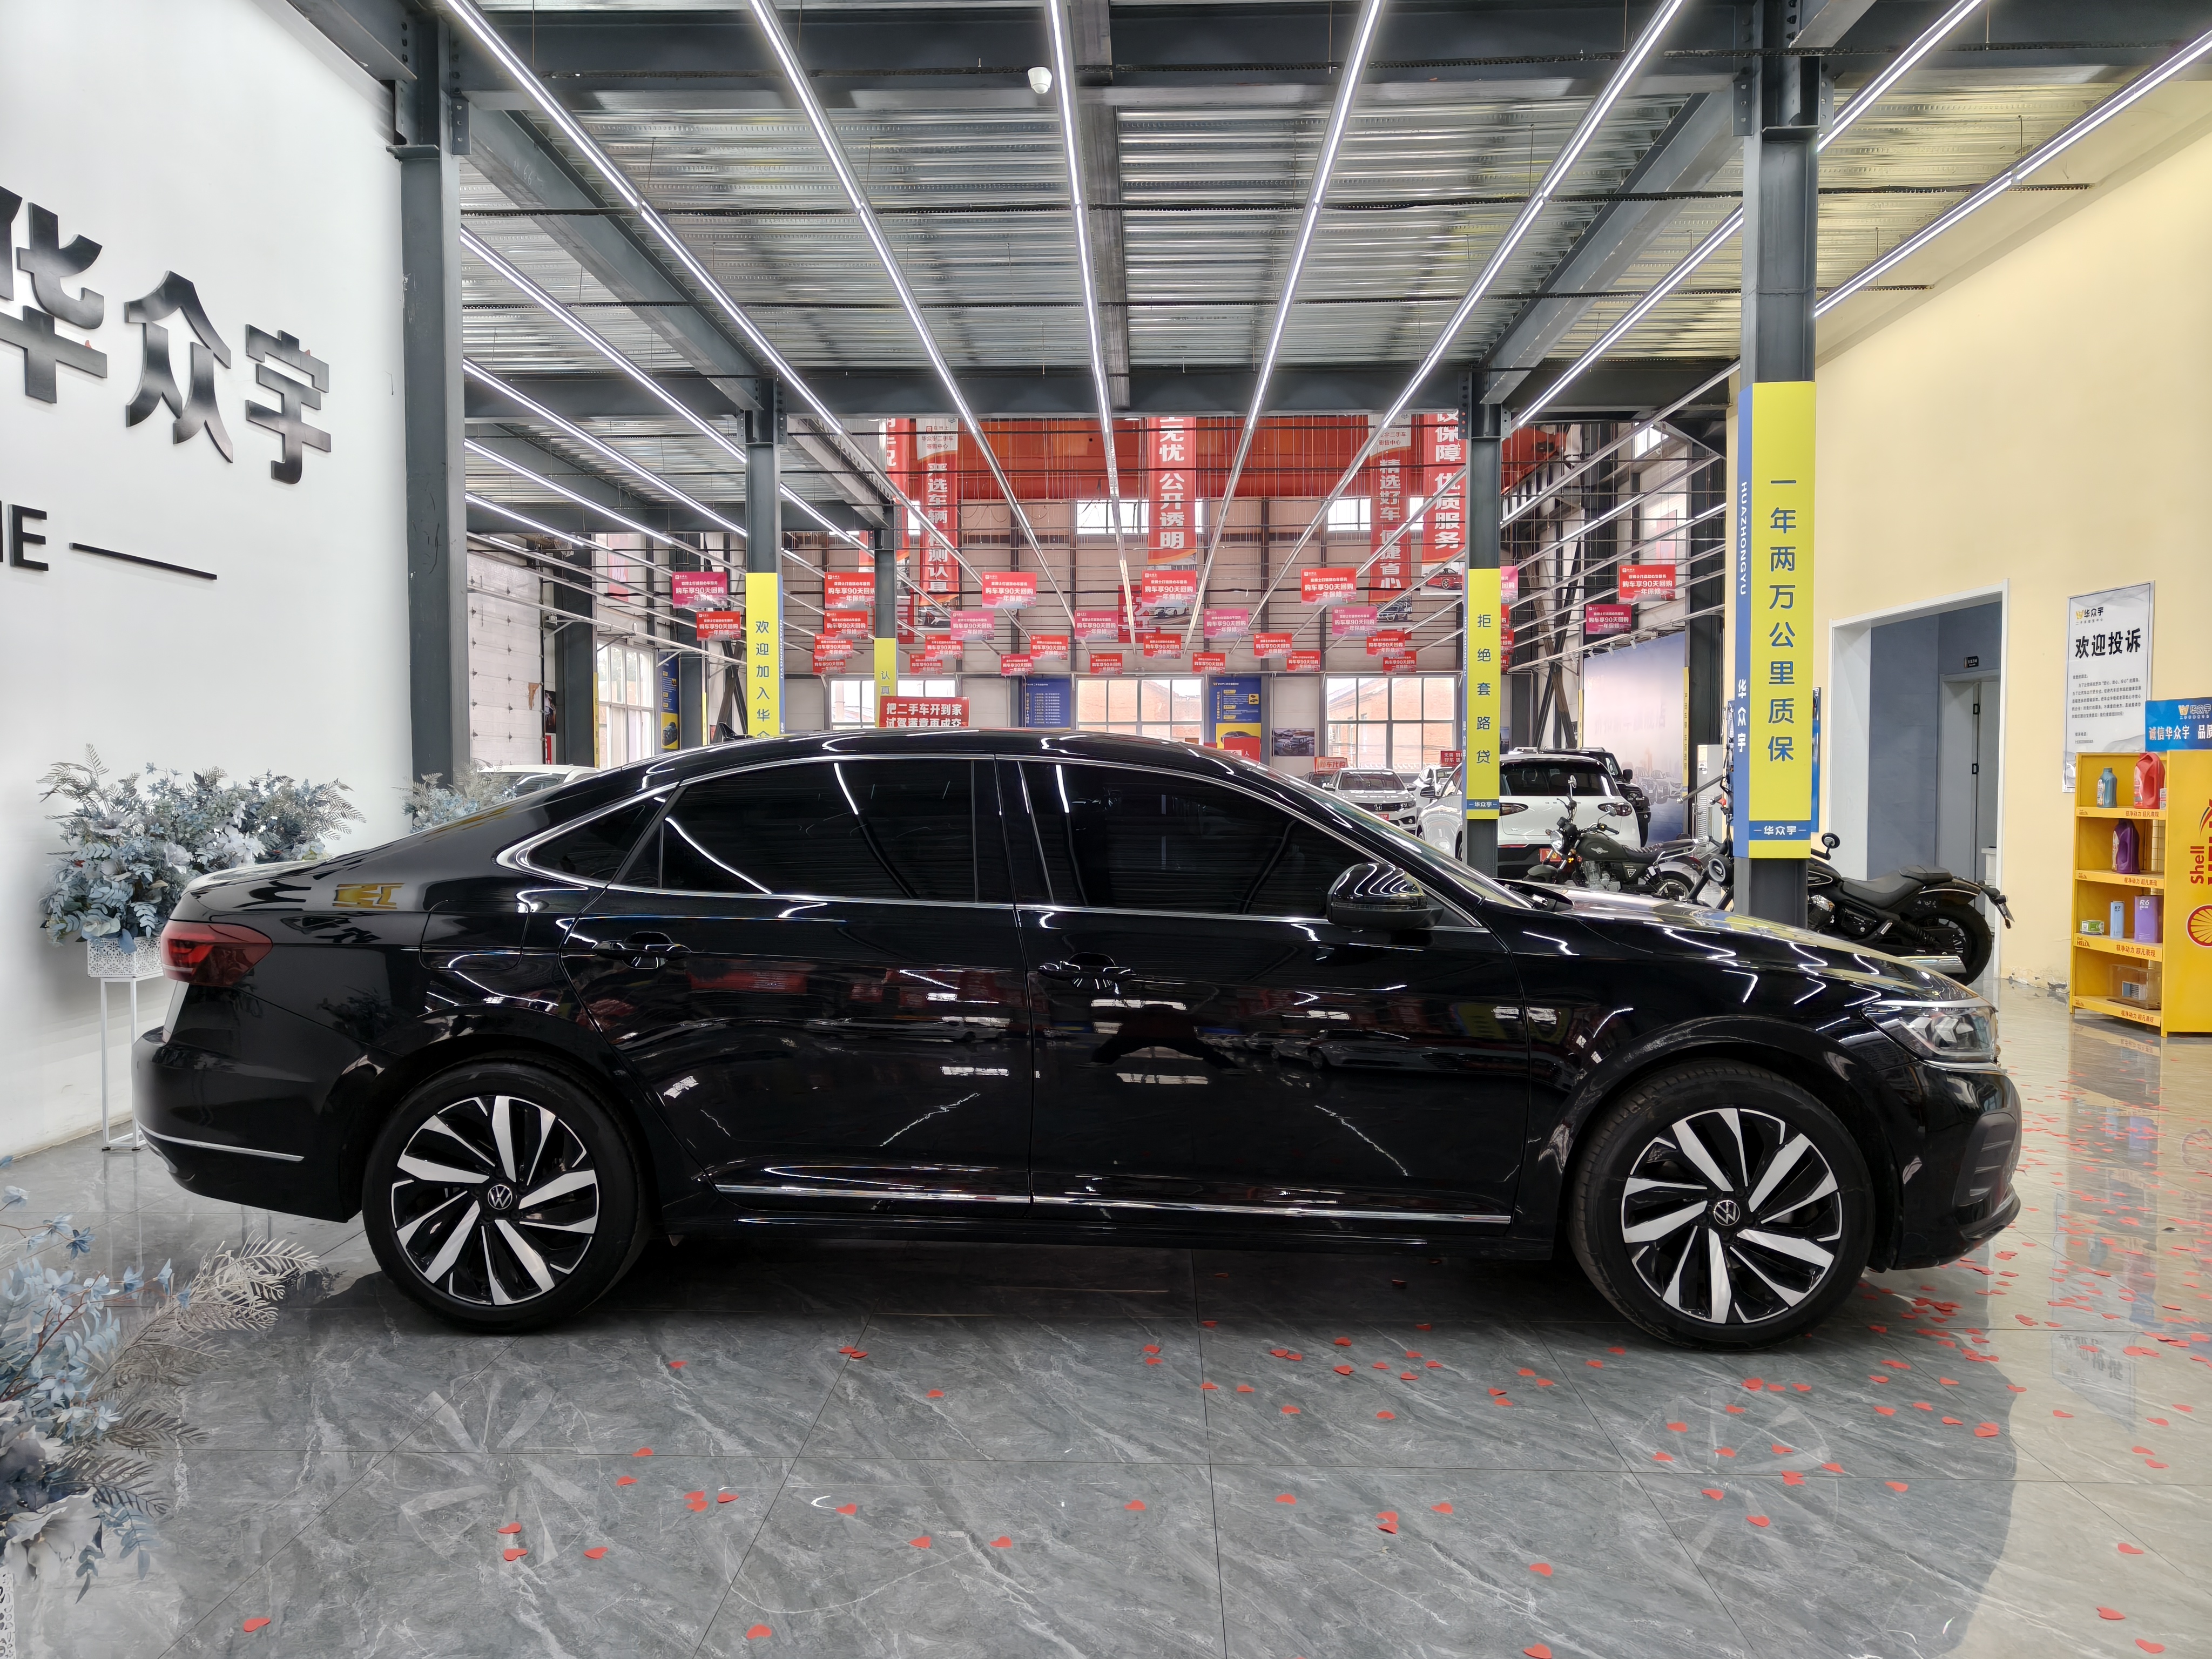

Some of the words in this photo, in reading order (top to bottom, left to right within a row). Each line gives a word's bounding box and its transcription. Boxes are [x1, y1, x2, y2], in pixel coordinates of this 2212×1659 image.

[928, 463, 948, 524] 严选车辆
[1379, 459, 1401, 521] 精选好车
[1159, 473, 1184, 549] 公开透明
[0, 501, 49, 571] E
[1768, 480, 1797, 761] 一年两万公里质保
[2084, 607, 2103, 617] 华众宇
[2075, 628, 2141, 658] 欢迎投诉
[881, 671, 891, 694] 认真
[1476, 614, 1492, 764] 拒绝套路贷
[886, 703, 962, 716] 把二手车开到家
[1737, 678, 1747, 752] 华众宇
[2190, 704, 2211, 714] 华众宇
[2149, 725, 2190, 740] 诚信华众宇
[1764, 826, 1797, 835] 华众宇
[2189, 846, 2204, 884] Shell
[2136, 947, 2155, 957] 超凡表现
